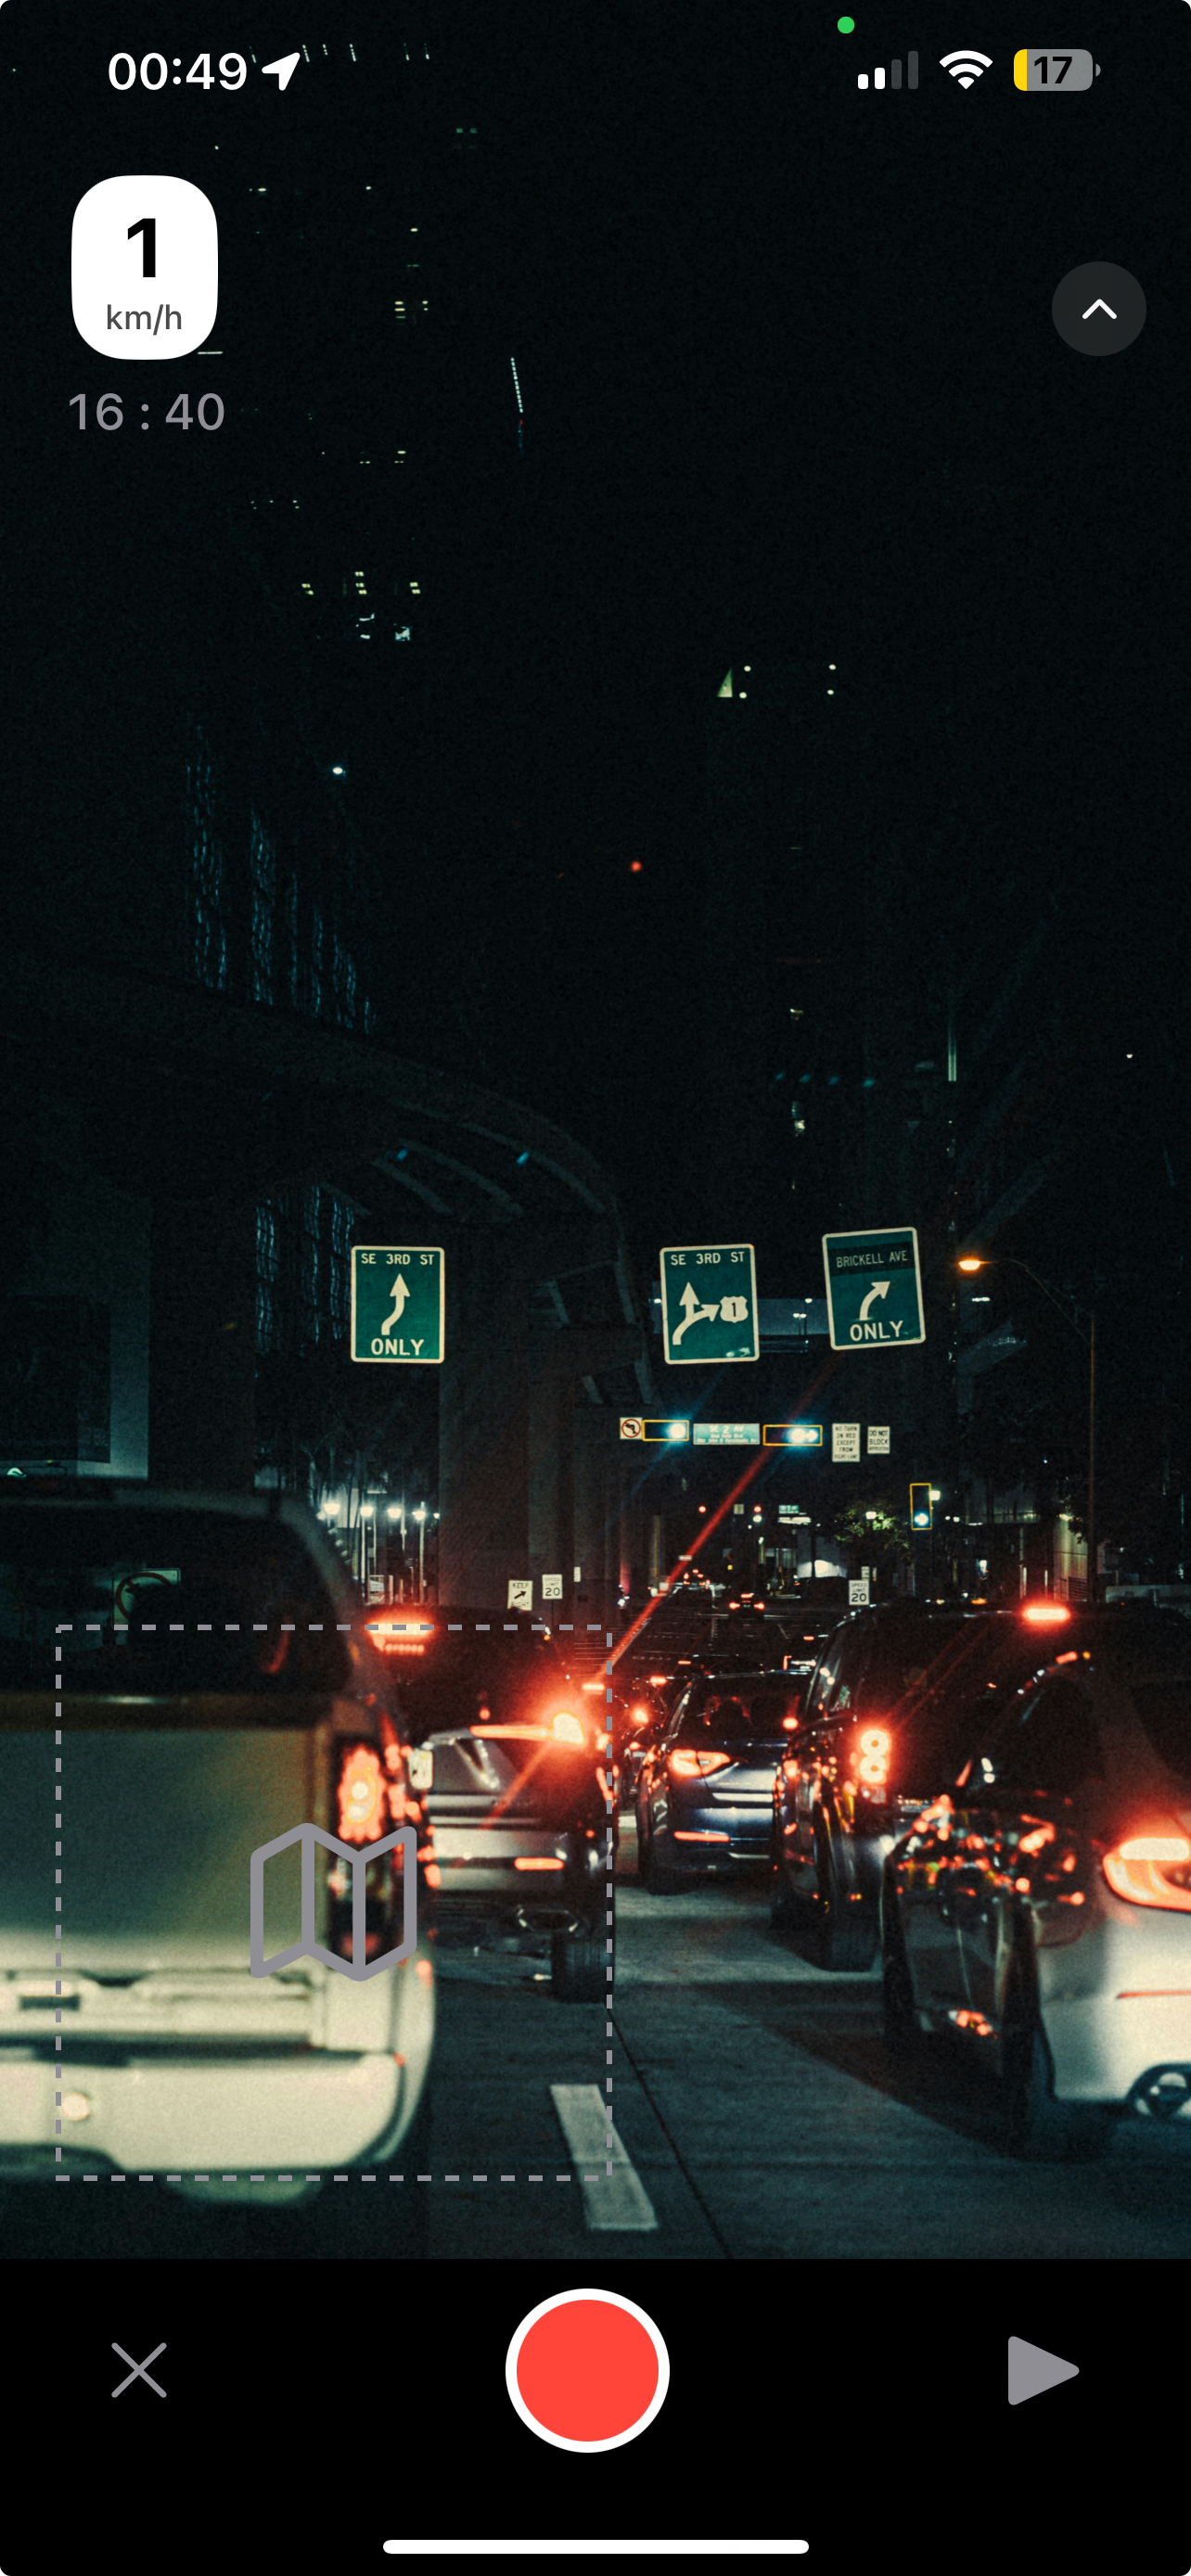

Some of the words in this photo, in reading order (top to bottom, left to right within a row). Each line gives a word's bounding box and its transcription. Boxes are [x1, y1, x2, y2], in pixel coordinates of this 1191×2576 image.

[361, 1253, 377, 1264] SE
[386, 1254, 411, 1265] 3RD
[420, 1255, 434, 1265] ST
[671, 1254, 686, 1266] SE
[696, 1252, 721, 1265] 3RD
[730, 1252, 745, 1263] ST
[836, 1253, 884, 1269] BRICKELL
[889, 1250, 908, 1262] AVE
[731, 1302, 736, 1318] 1
[850, 1320, 903, 1342] ONLY
[370, 1337, 425, 1356] ONLY
[723, 1425, 730, 1435] 2
[545, 1588, 560, 1596] 20
[851, 1592, 867, 1602] 20
